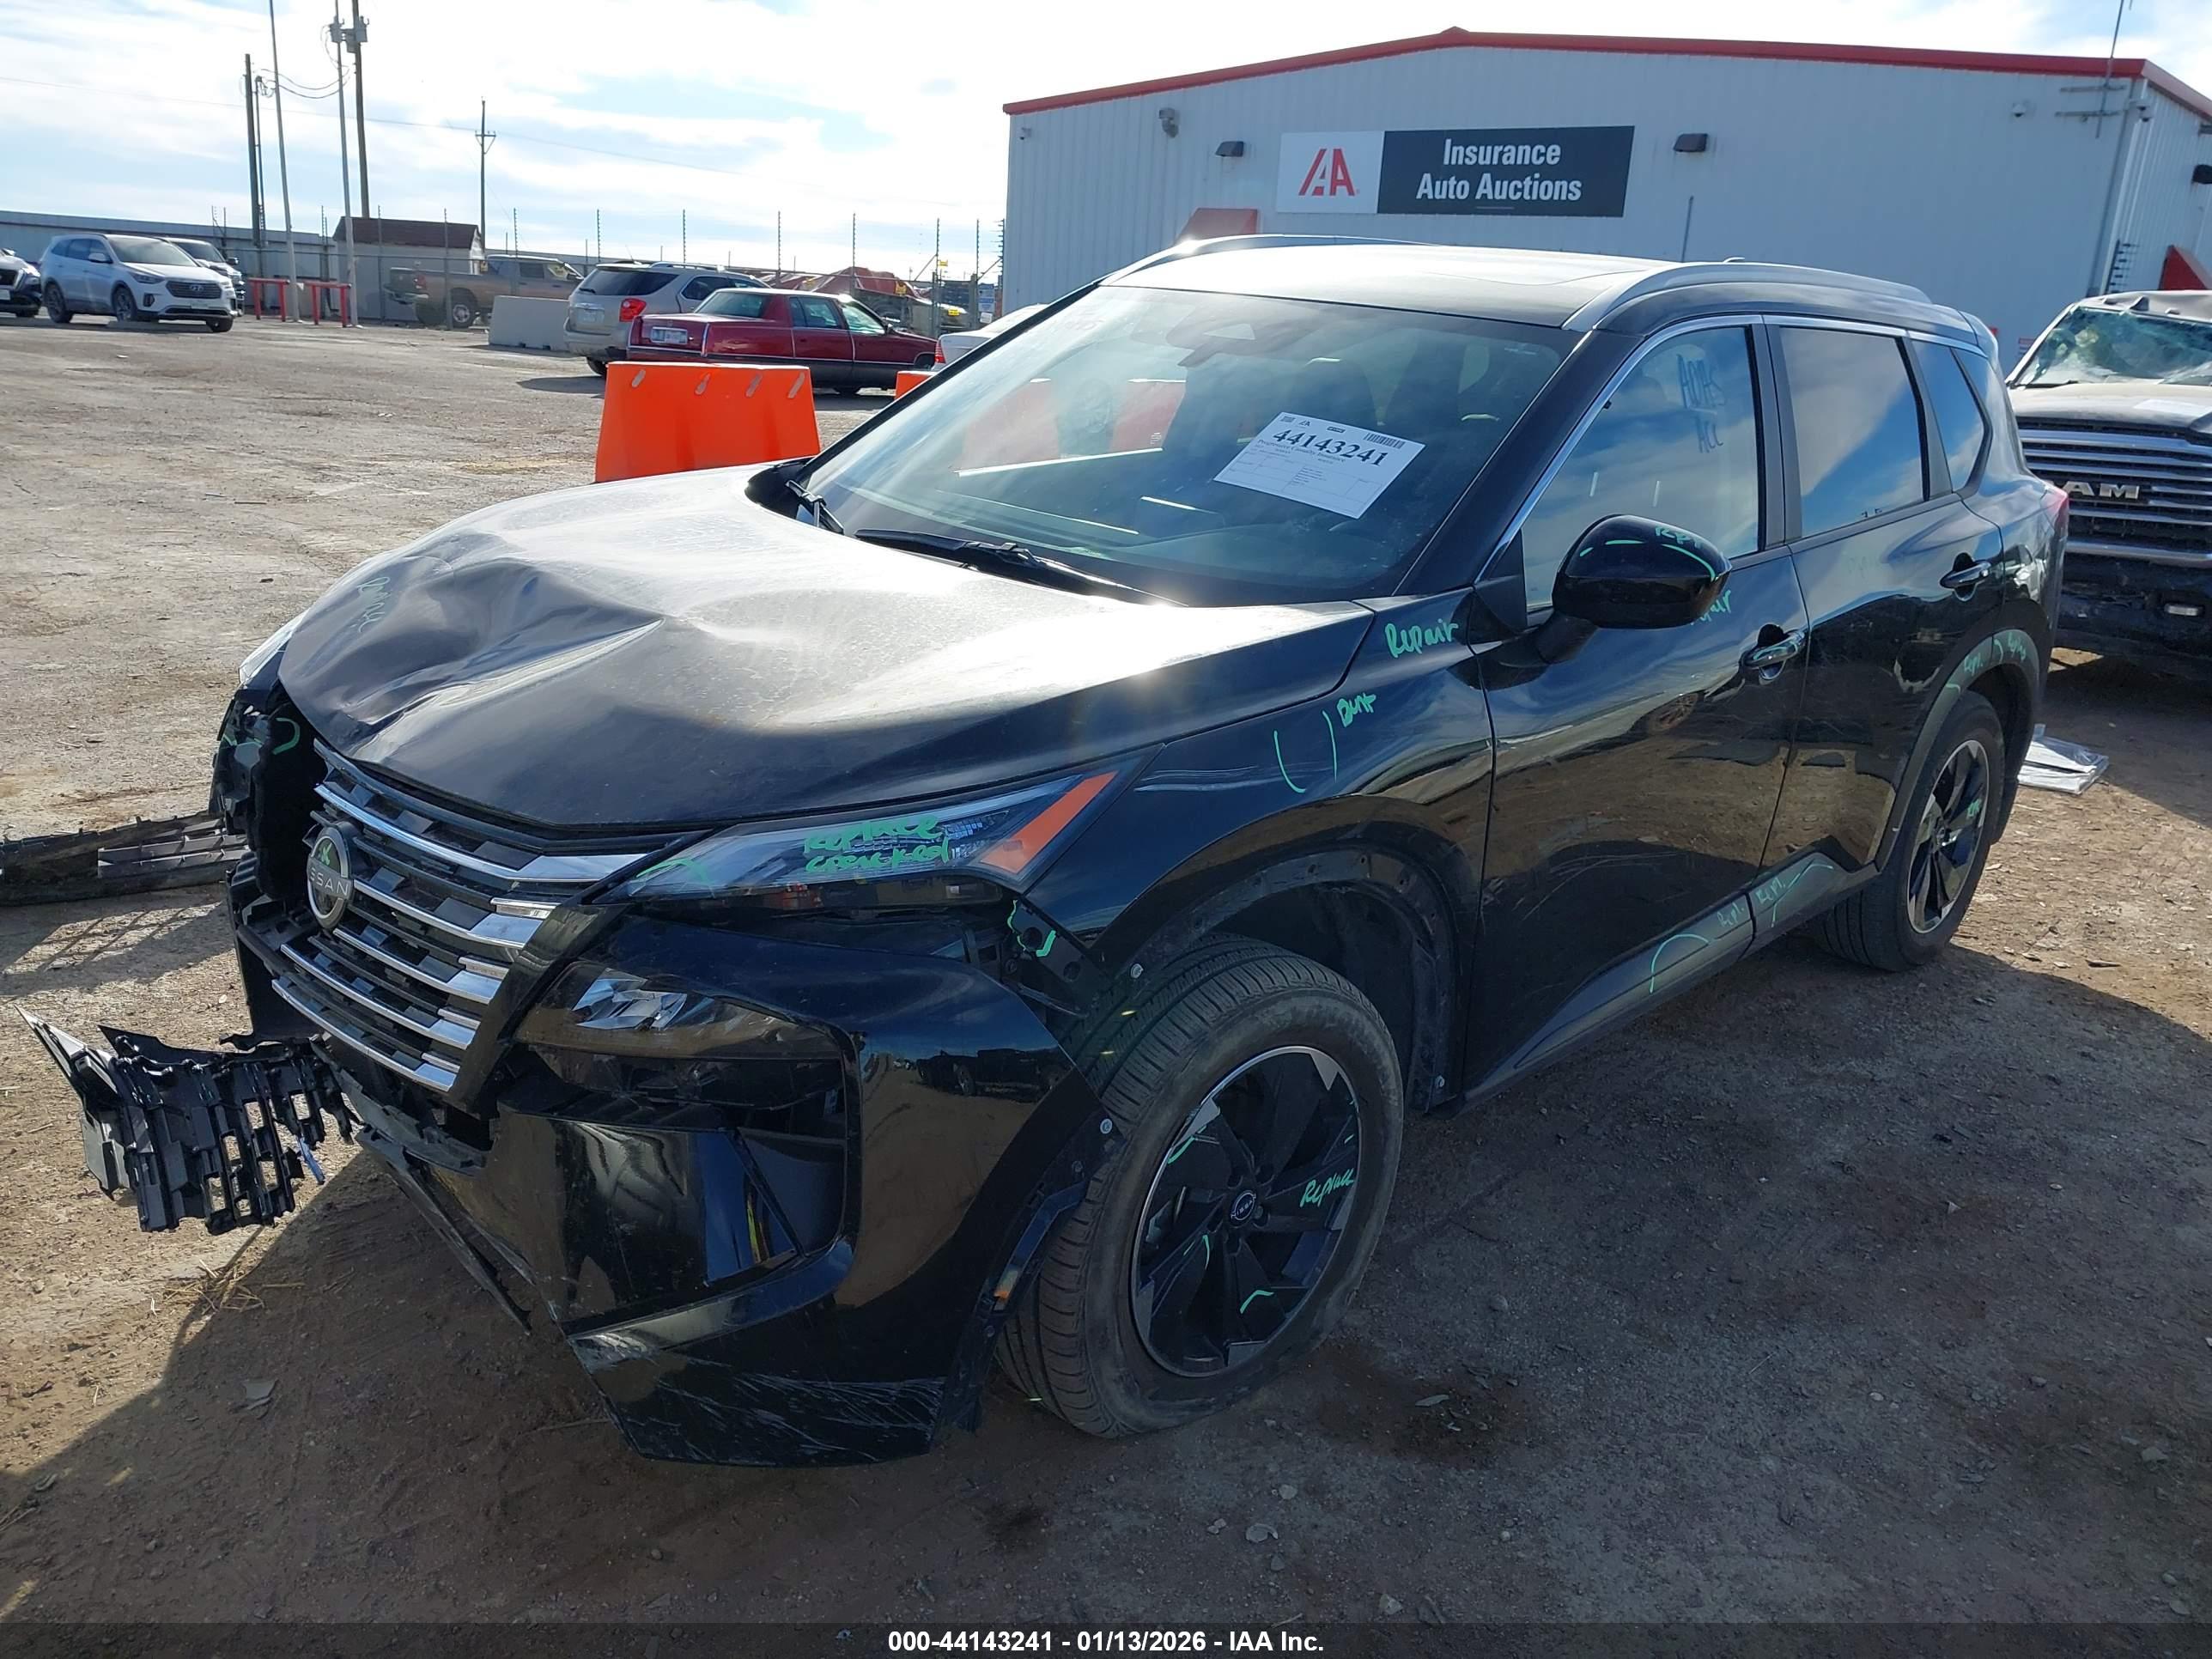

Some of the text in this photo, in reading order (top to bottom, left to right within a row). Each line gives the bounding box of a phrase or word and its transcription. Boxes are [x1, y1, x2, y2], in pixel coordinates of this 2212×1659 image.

[1443, 138, 1561, 166] Insurance
[1416, 173, 1582, 201] Auto Auctions
[1273, 429, 1389, 467] 44143241
[2045, 479, 2140, 500] AM
[1384, 619, 1459, 659] Repair
